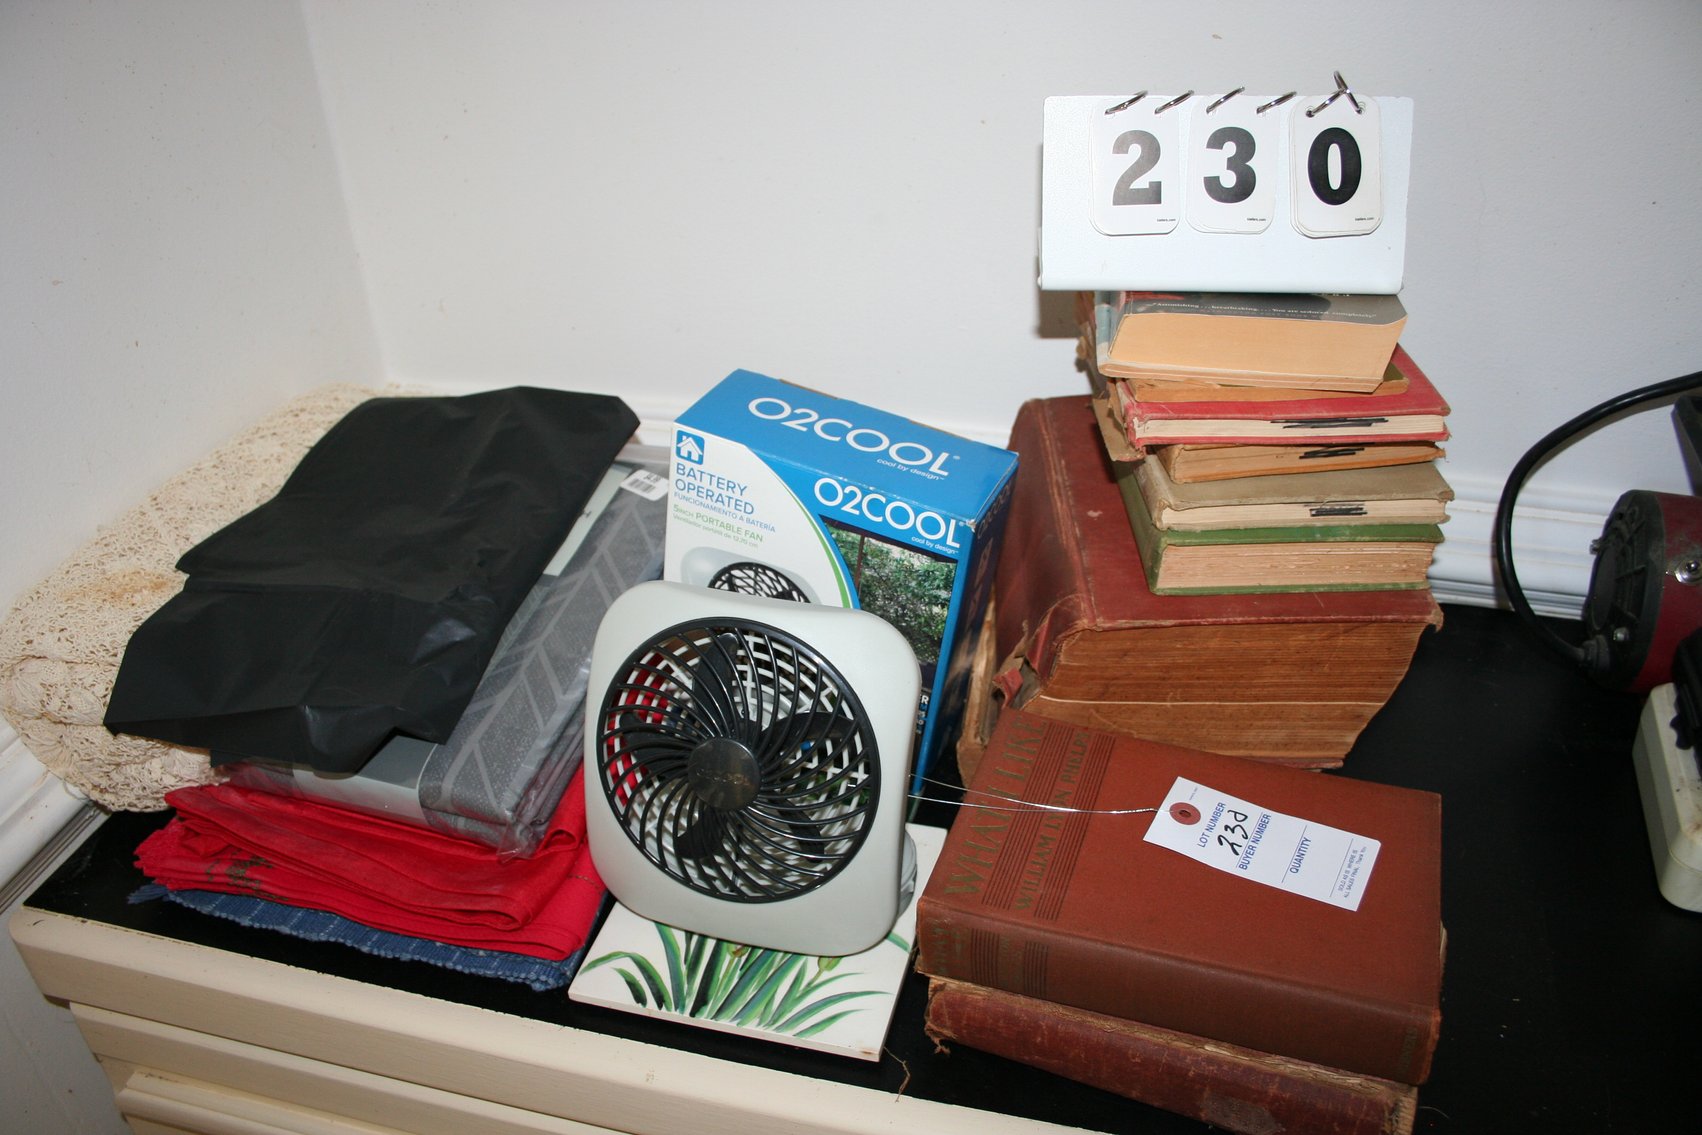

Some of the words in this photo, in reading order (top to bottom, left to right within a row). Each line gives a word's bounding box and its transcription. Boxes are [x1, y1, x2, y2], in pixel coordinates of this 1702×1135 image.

[1112, 129, 1162, 206] 2
[1203, 126, 1257, 204] 3
[748, 397, 949, 477] O2COOL
[676, 462, 748, 496] BATTERY
[877, 458, 896, 468] cool
[673, 492, 738, 519] FUNCIONAMIENTO
[675, 478, 754, 515] OPERATED
[814, 477, 960, 548] O2COOL
[695, 512, 743, 535] PORTABLE
[744, 529, 764, 542] FAN
[911, 536, 926, 544] cool
[925, 540, 934, 548] by
[943, 800, 1012, 895] WHAT
[994, 715, 1047, 782] LIKE
[1196, 831, 1210, 848] LOT
[1205, 802, 1226, 833] NUMBER
[1238, 844, 1257, 870] BUYER
[1251, 813, 1272, 845] NUMBER
[1289, 836, 1311, 874] QUANTITY
[1014, 833, 1057, 911] WILLIAM
